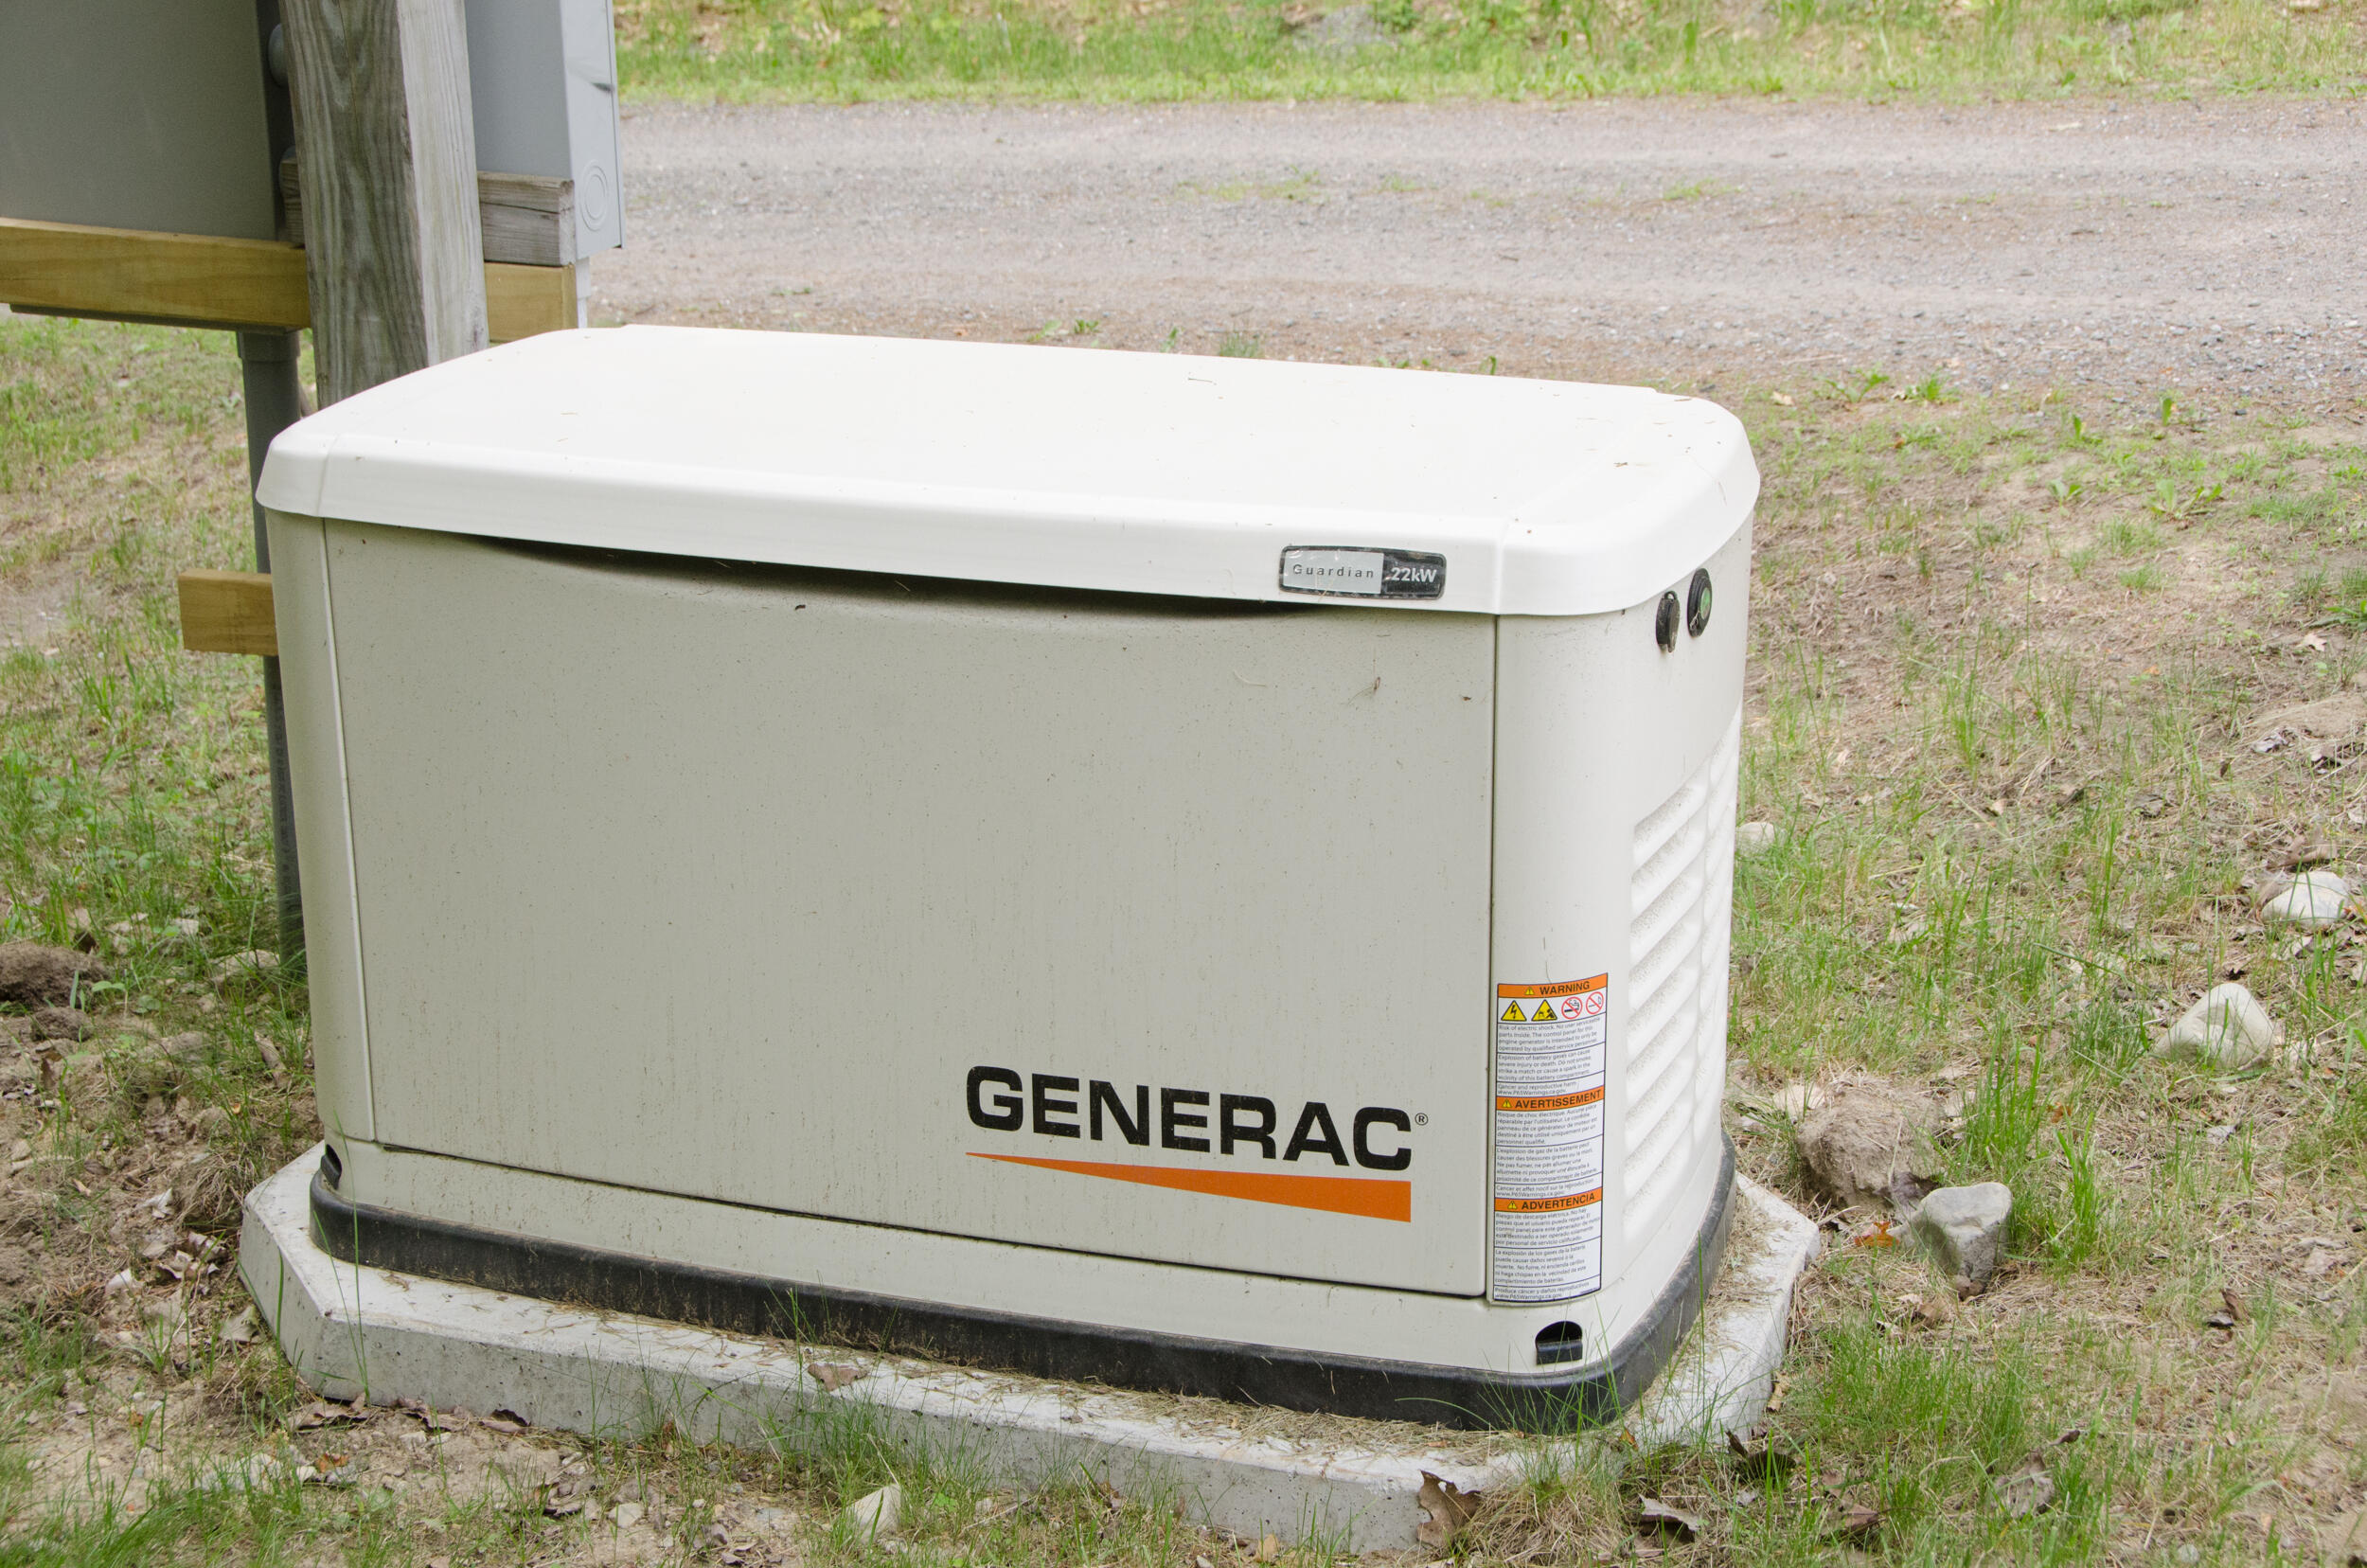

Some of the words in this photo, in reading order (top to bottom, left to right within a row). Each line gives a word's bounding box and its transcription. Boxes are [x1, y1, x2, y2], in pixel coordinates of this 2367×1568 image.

[1292, 563, 1374, 579] Guardian
[1390, 566, 1437, 583] 22kW
[1539, 981, 1590, 995] WARNING
[1515, 1089, 1601, 1108] AVERTISSEMENT
[966, 1065, 1412, 1171] GENERAC
[1522, 1193, 1595, 1210] ADVERTENCIA
